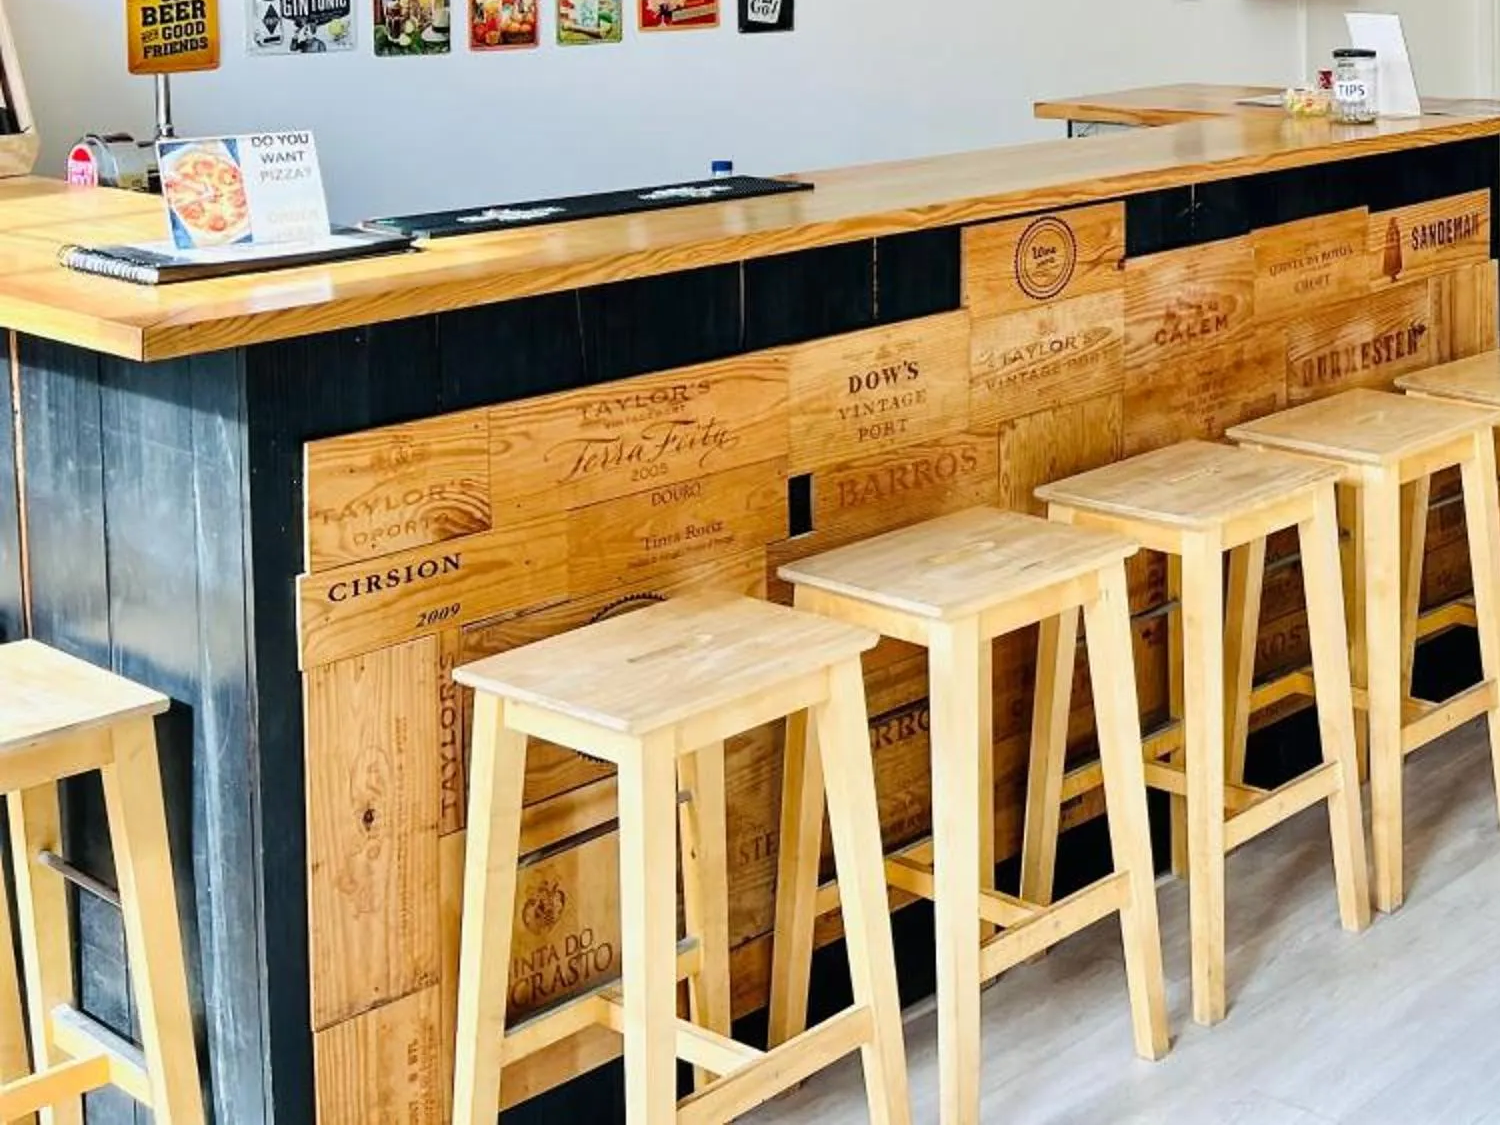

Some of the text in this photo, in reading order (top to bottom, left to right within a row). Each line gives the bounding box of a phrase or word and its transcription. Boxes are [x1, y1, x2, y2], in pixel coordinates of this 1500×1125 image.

[141, 0, 207, 28] BEER
[161, 21, 206, 41] GOOD
[143, 36, 209, 59] FRIENDS
[1339, 84, 1366, 96] TIPS
[251, 133, 309, 148] DO YOU
[261, 150, 305, 165] WANT
[1411, 211, 1481, 252] SANDEMAN
[848, 359, 920, 395] DOW'S
[576, 379, 711, 420] TAYLOR'S
[837, 387, 928, 421] VINTAGE
[857, 418, 908, 443] PORT
[837, 445, 978, 509] BARROS
[314, 477, 475, 525] TAYLOR'S
[326, 551, 464, 604] CIRSION
[416, 602, 463, 629] 2009
[565, 927, 595, 957] DO
[510, 941, 614, 1007] CRASTO
